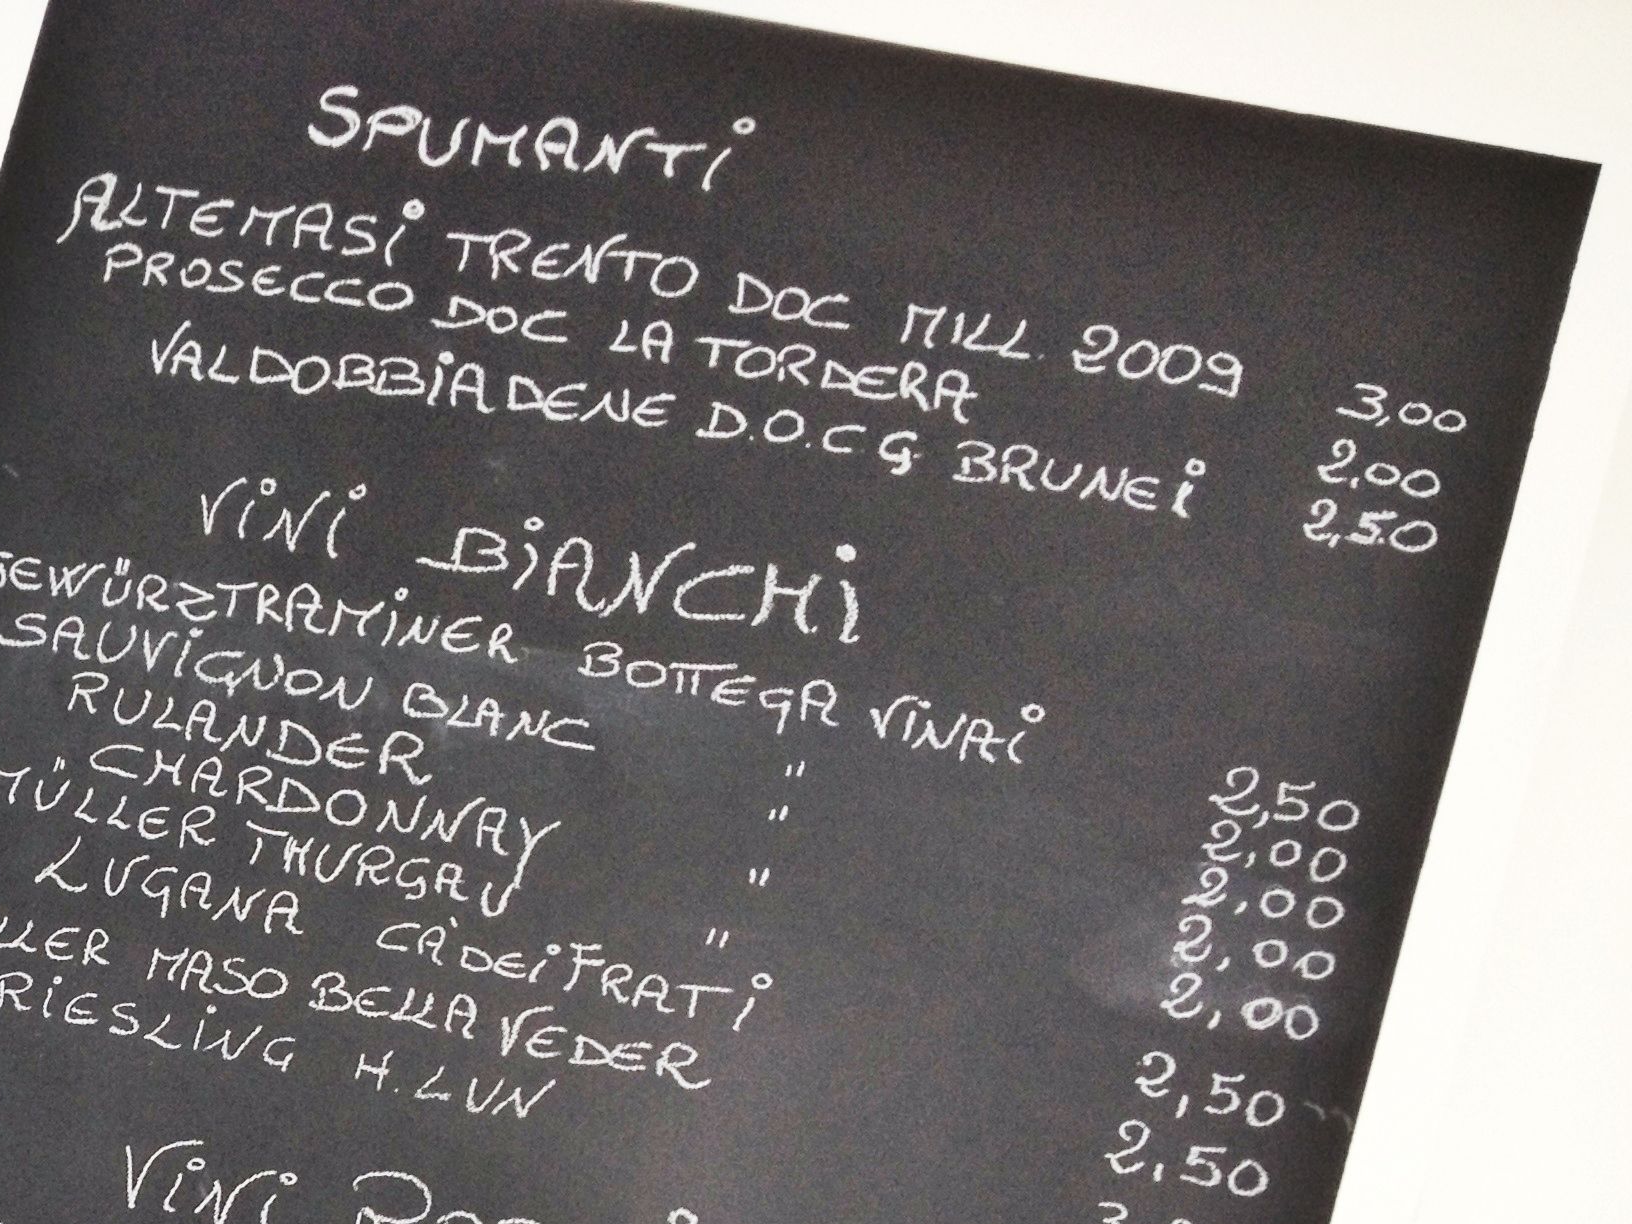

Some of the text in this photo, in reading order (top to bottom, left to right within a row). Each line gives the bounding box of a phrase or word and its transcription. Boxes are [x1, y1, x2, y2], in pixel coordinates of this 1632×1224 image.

[103, 243, 1442, 499] PROSECCO DOC LA TORDERA 2,00
[446, 229, 699, 299] TRENTO
[727, 272, 850, 330] DOC
[1072, 325, 1243, 397] 2009
[1335, 383, 1467, 433] 3,00
[1302, 499, 1439, 554] 2,50
[68, 672, 432, 786] RULANDER
[1181, 866, 1345, 929] 2,00
[402, 682, 595, 752] BLANC
[1201, 819, 1348, 884] 2,00
[577, 641, 839, 735] BOTTEGA
[1208, 766, 1360, 832] 2,50
[89, 745, 562, 889] CHARDONNAY
[1173, 914, 1336, 980] 2,00
[246, 820, 514, 918] THURGAU
[1160, 972, 1320, 1040] 2,00
[35, 834, 304, 936] LUGANA
[1135, 1050, 1285, 1128] 2,50
[146, 947, 288, 1000] MASO
[308, 972, 478, 1040] BELLA
[499, 1004, 711, 1091] VEDER
[1105, 1119, 1269, 1197] 2,50
